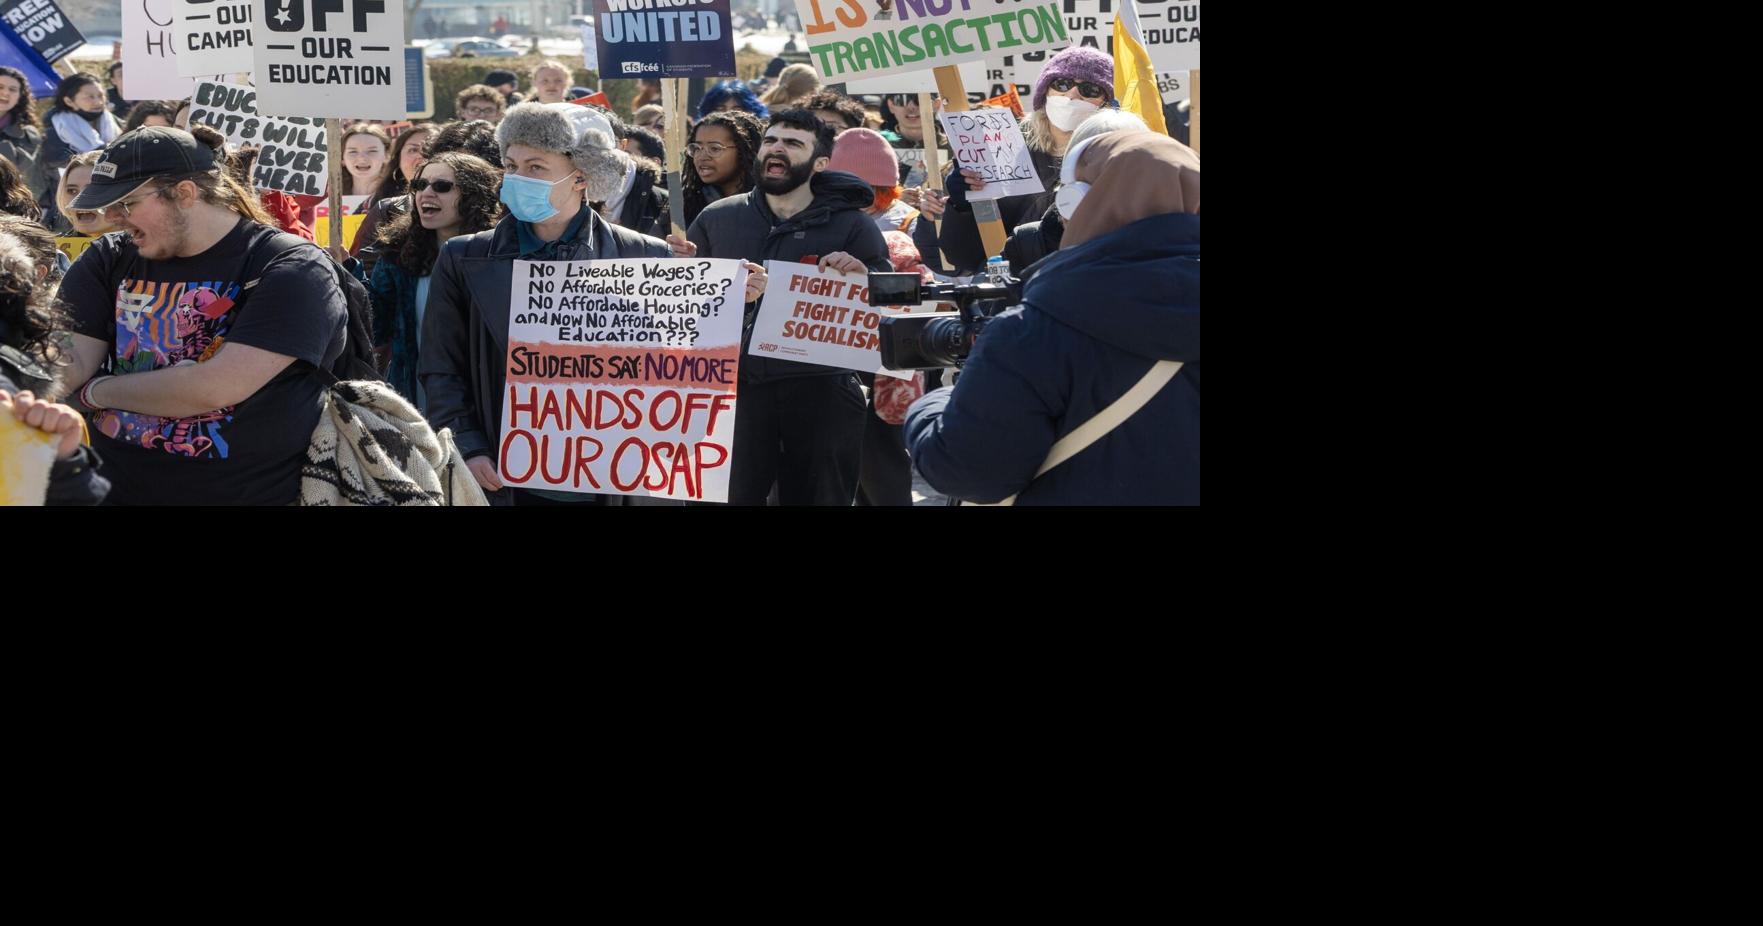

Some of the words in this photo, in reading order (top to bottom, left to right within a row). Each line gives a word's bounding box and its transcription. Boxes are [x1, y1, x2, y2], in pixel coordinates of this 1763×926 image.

[2, 0, 50, 26] REE
[217, 4, 252, 25] OU
[805, 0, 868, 35] IS
[1064, 17, 1098, 31] UR
[1167, 5, 1200, 23] OU
[600, 10, 721, 43] UNITED
[301, 37, 354, 59] OUR
[808, 3, 1069, 77] TRANSACTION
[268, 64, 391, 86] EDUCATION
[262, 121, 328, 152] WILL
[959, 131, 1002, 146] PLAN
[958, 148, 986, 163] CUT
[253, 165, 320, 195] HEAL
[565, 262, 634, 279] Liveable
[642, 261, 712, 281] Wages?
[560, 279, 635, 296] Affordable
[638, 278, 732, 297] Groceries?
[789, 274, 847, 299] FIGHT
[558, 296, 640, 312] Affordable
[643, 297, 725, 317] Housing?
[792, 301, 850, 324] FIGHT
[514, 311, 548, 325] and
[611, 313, 697, 331] Affordable
[510, 346, 604, 379] STUDENTS
[607, 355, 642, 379] SAY:
[509, 385, 645, 431] HANDS
[649, 389, 737, 436] OFF
[500, 429, 604, 489] OUR
[609, 436, 729, 500] OSAP
